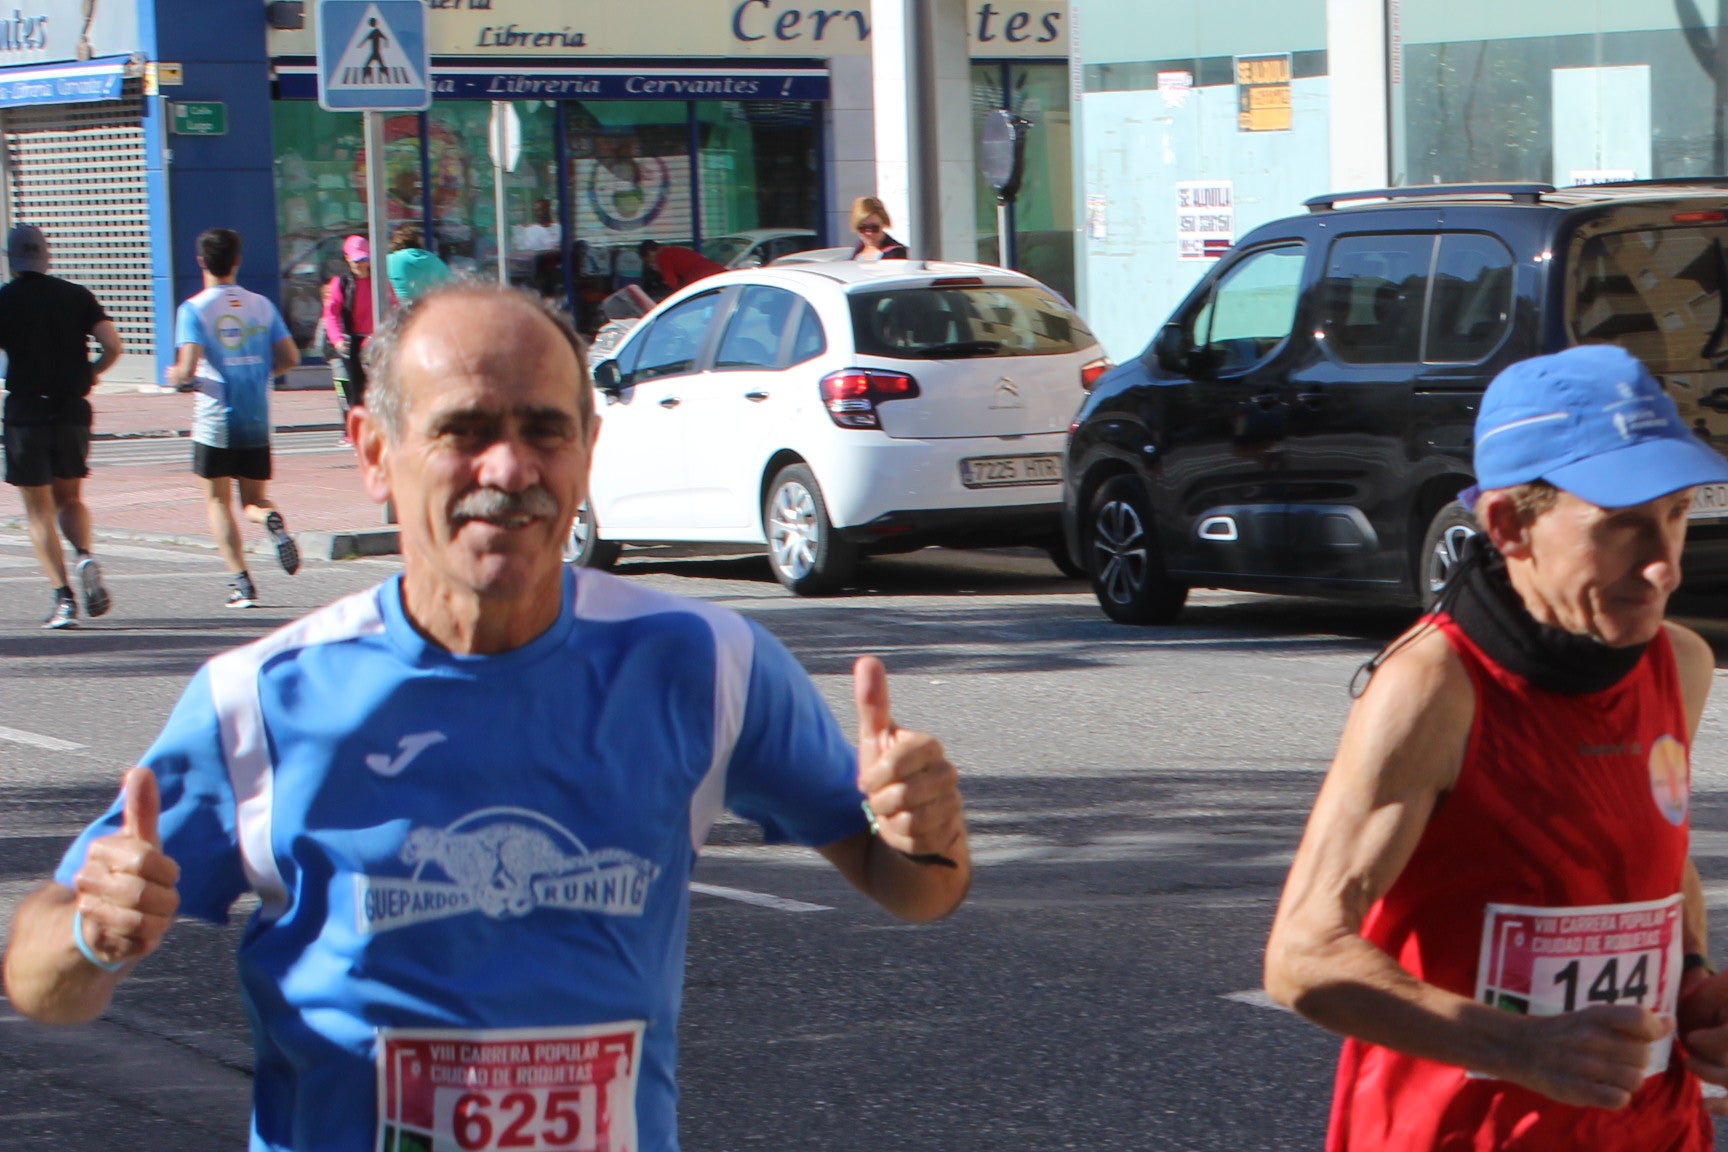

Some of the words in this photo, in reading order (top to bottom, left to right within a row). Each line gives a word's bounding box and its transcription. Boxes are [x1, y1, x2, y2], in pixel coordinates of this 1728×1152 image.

[625, 76, 761, 94] Cervantes
[1554, 954, 1649, 1012] 144
[430, 1044, 456, 1062] VIII
[461, 1043, 531, 1064] CARRERA
[534, 1040, 600, 1062] POPULAR
[453, 1090, 581, 1151] 625
